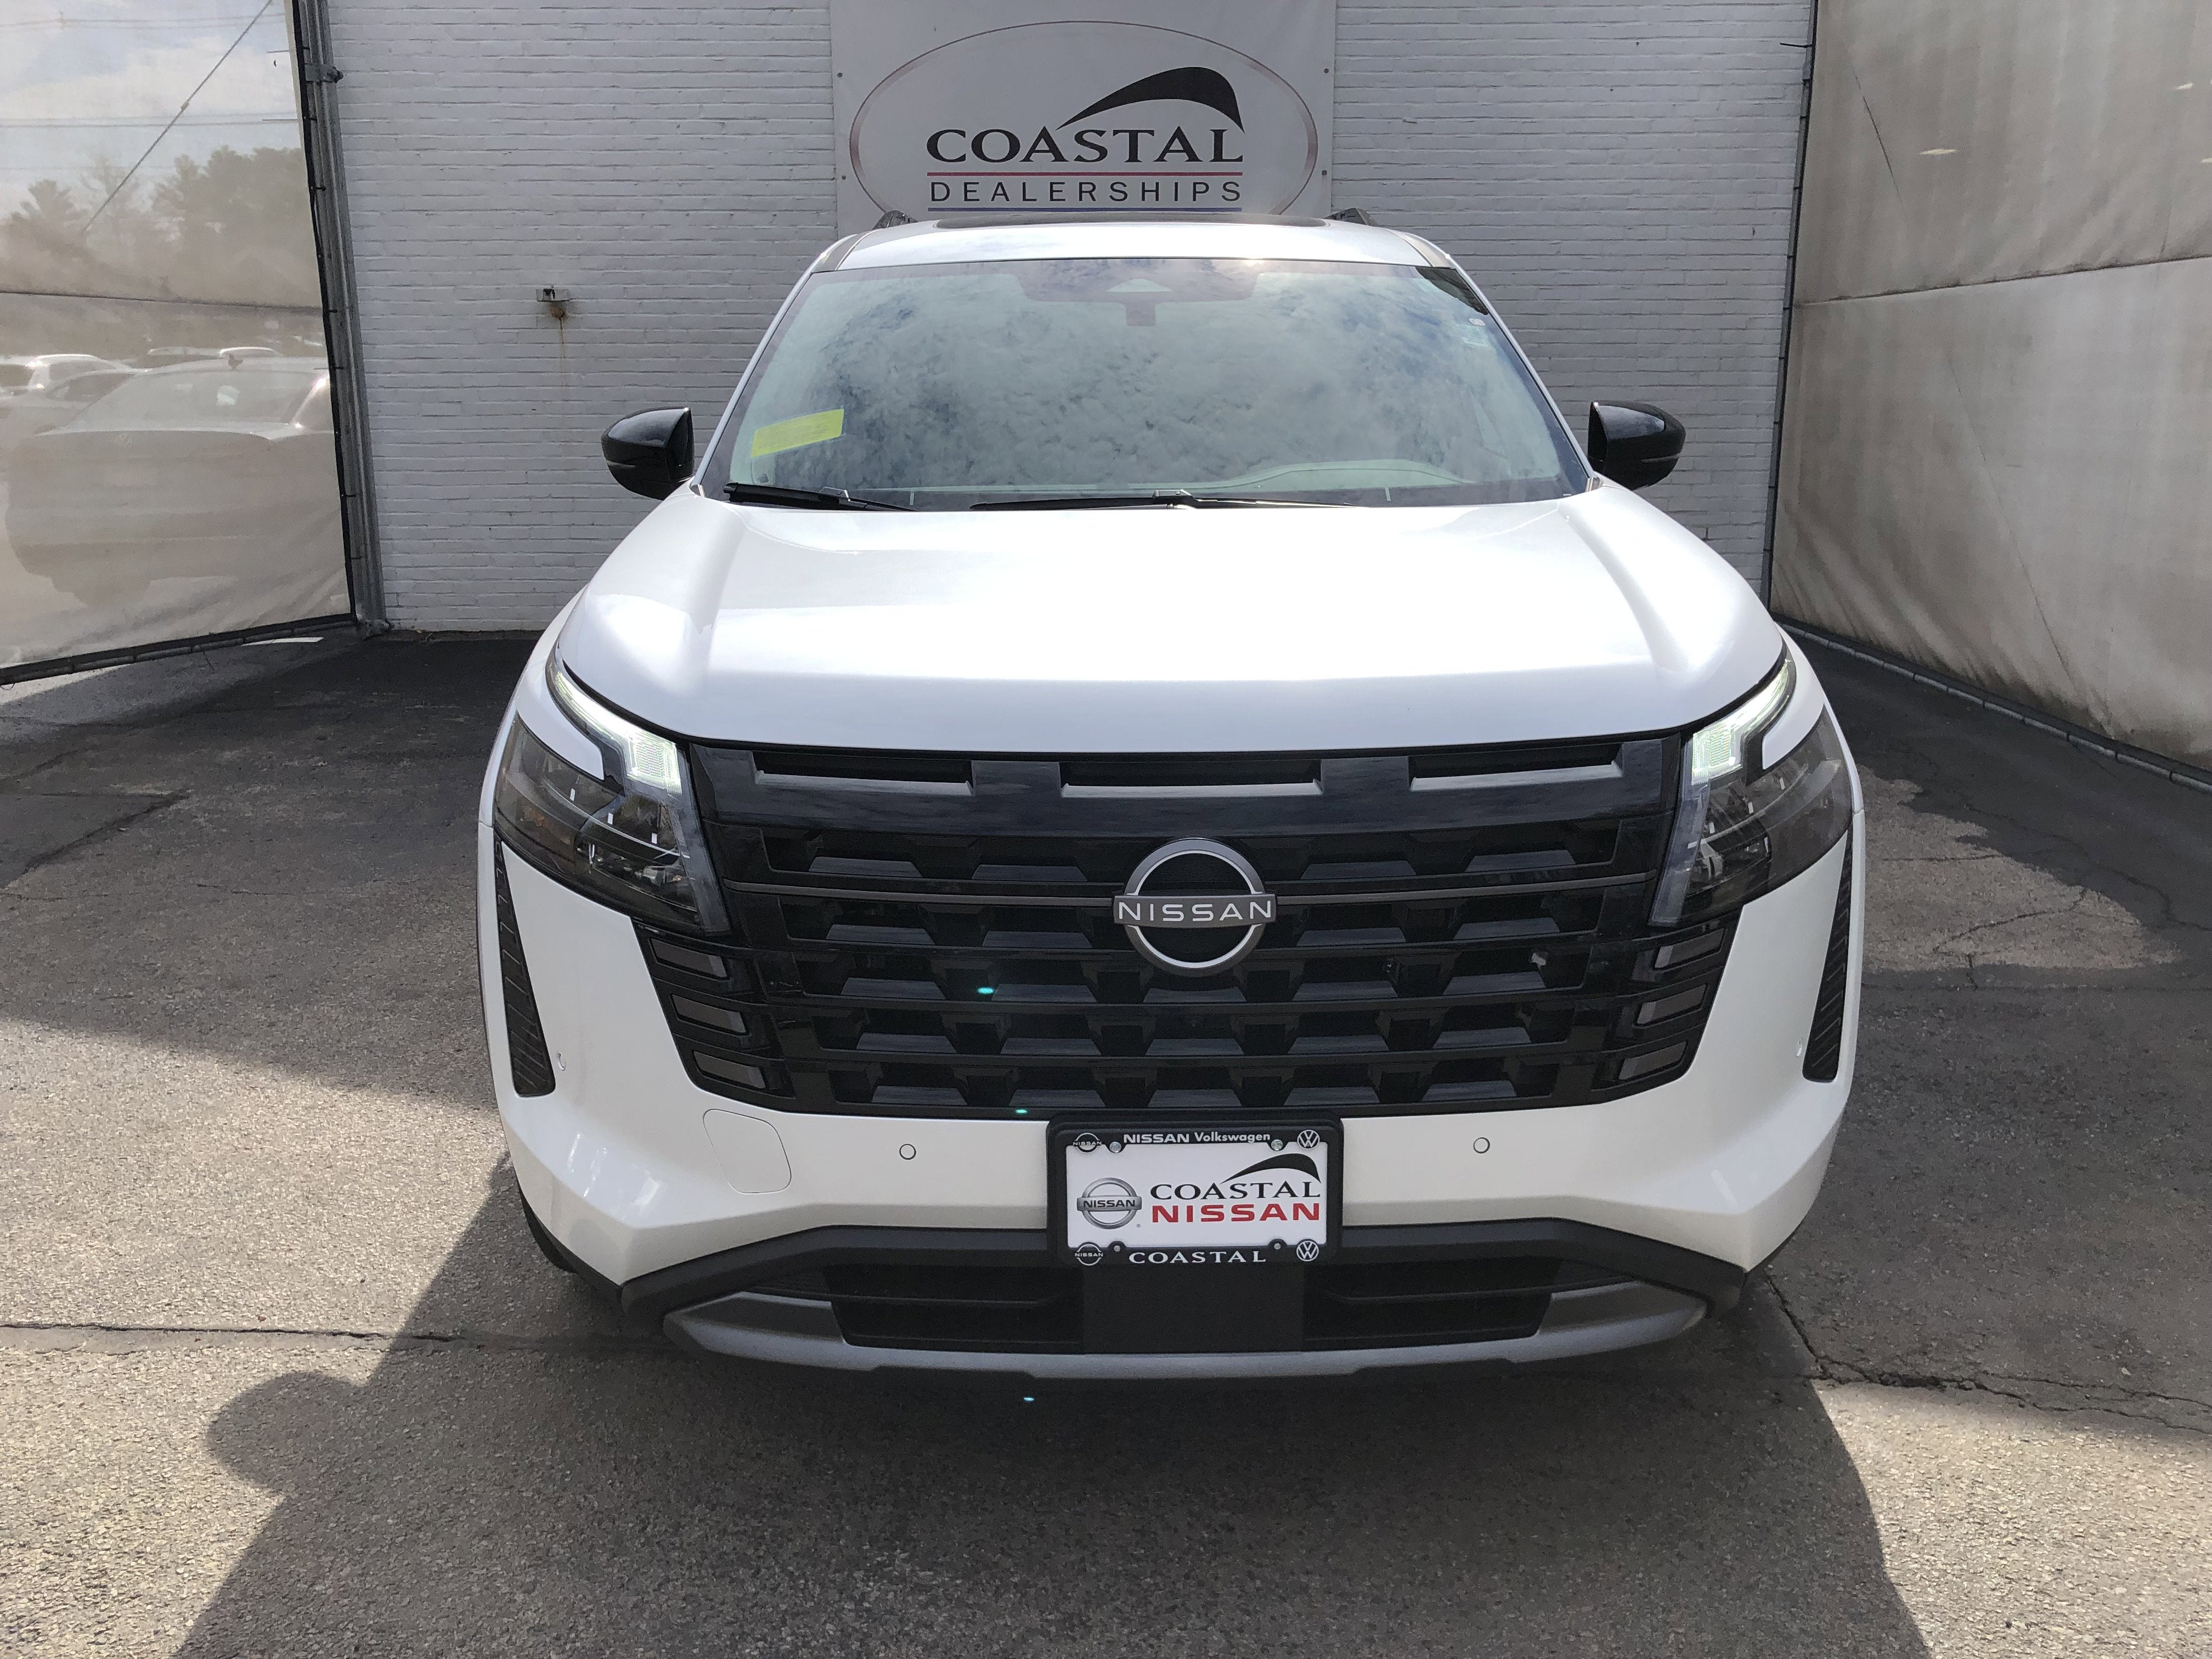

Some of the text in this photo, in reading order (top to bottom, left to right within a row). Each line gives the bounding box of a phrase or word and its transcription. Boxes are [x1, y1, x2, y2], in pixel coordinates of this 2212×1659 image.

[926, 126, 1244, 163] COASTAL
[930, 181, 1241, 202] DEALERSHIPS
[1119, 900, 1271, 922] NISSAN
[1124, 1132, 1271, 1143] NISSAN Volkswagen
[1150, 1181, 1321, 1200] COASTAL
[1083, 1199, 1136, 1209] NISSAN
[1152, 1202, 1319, 1223] NISSAN
[1128, 1250, 1266, 1264] COASTAL
